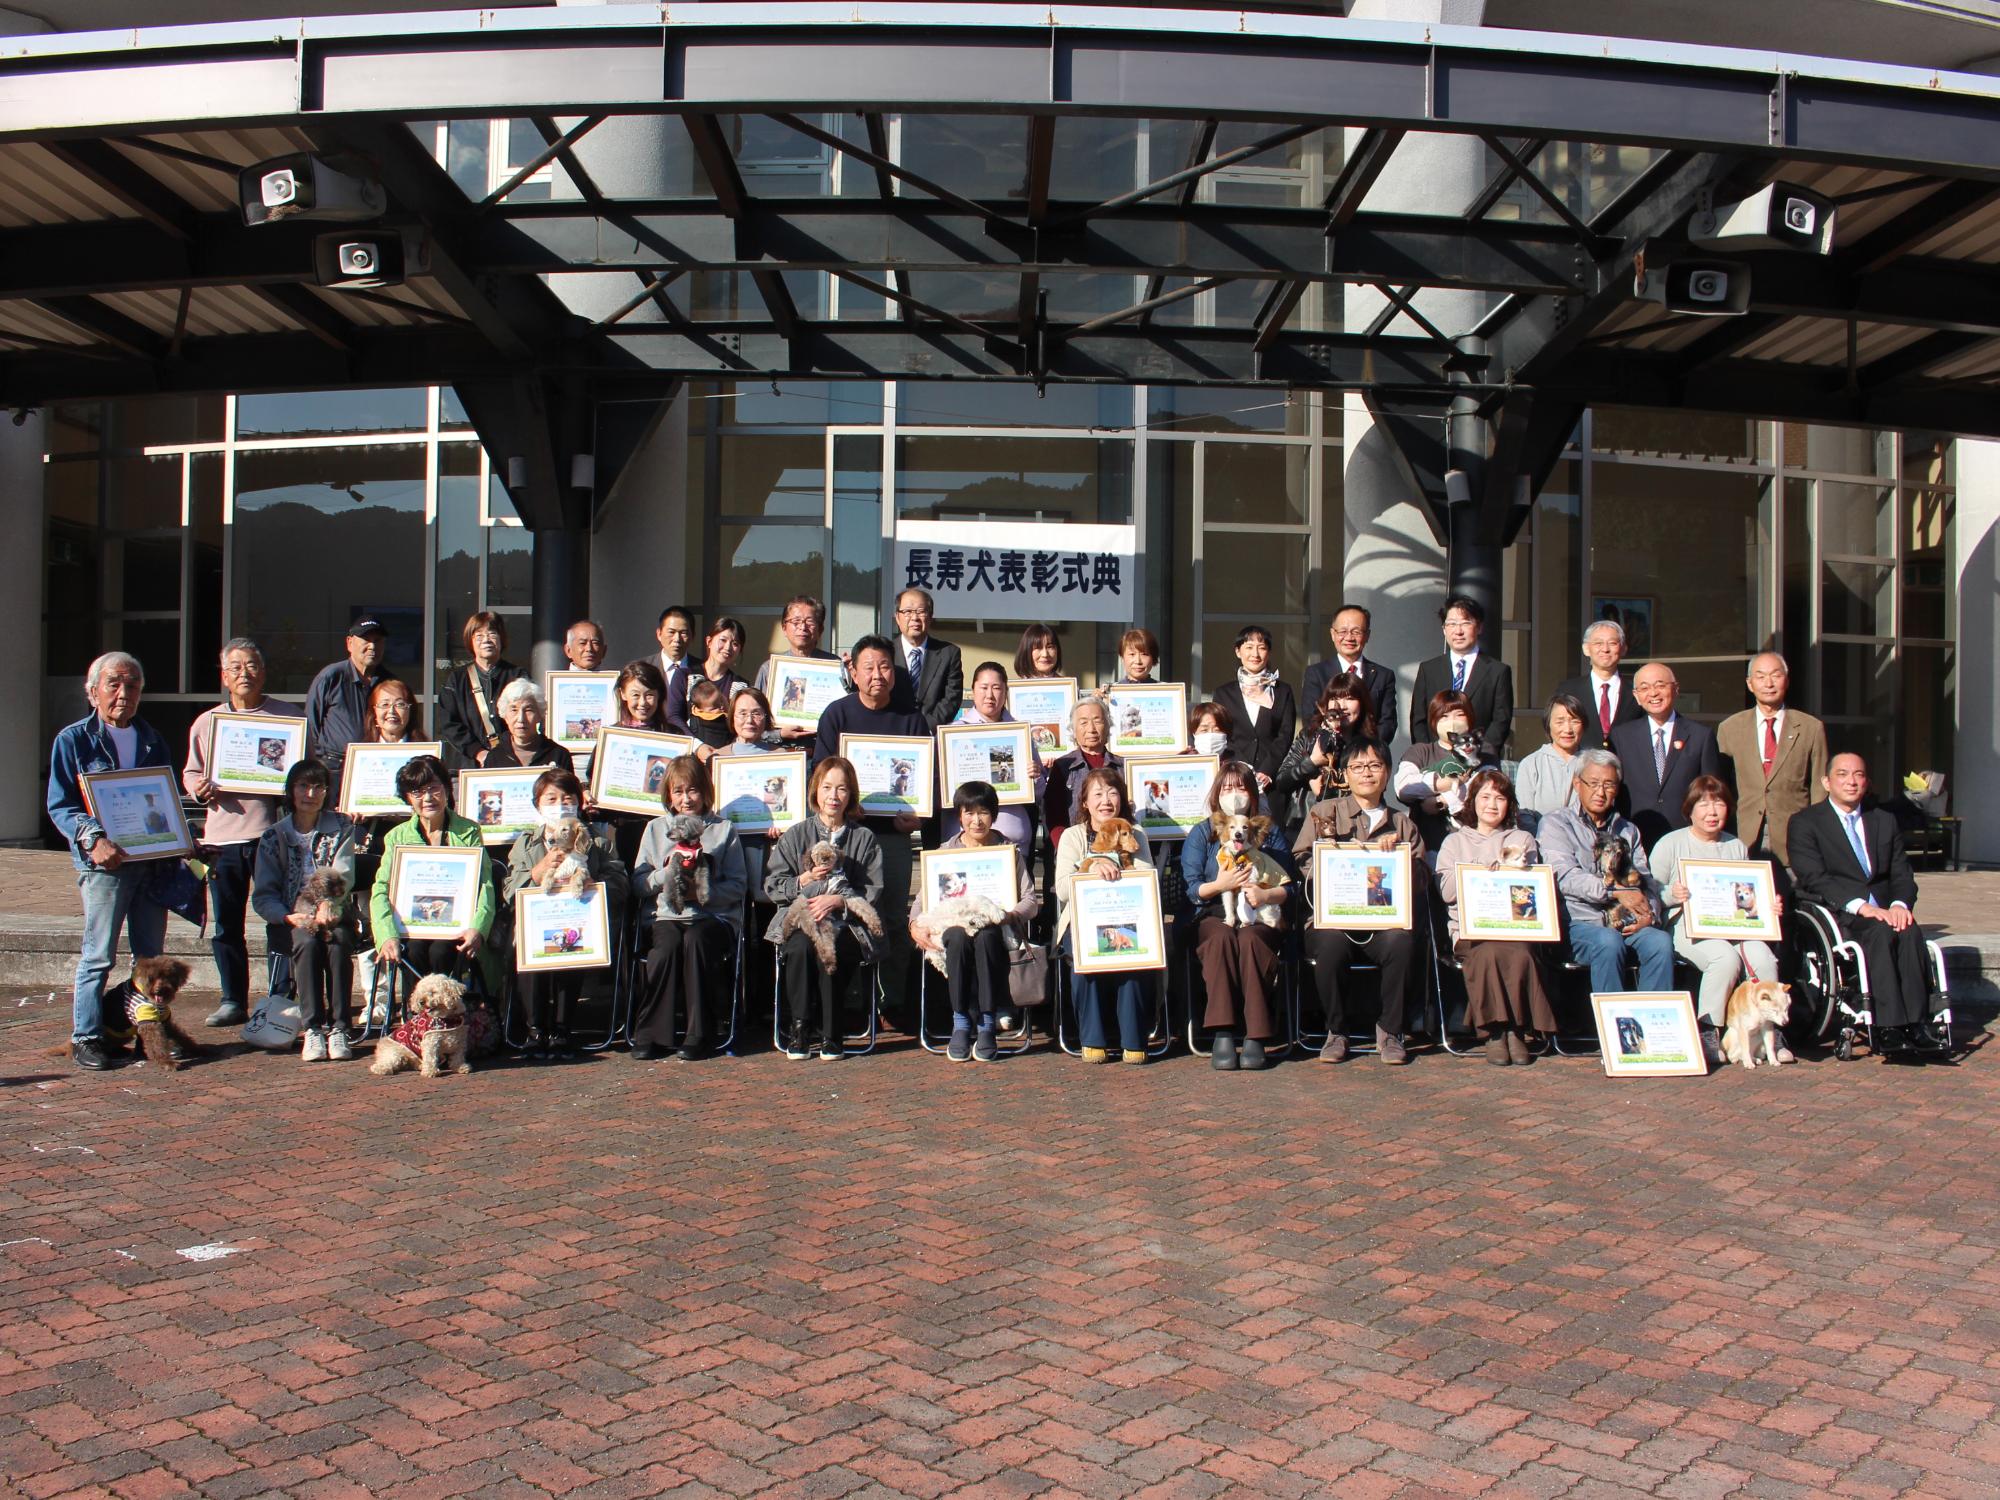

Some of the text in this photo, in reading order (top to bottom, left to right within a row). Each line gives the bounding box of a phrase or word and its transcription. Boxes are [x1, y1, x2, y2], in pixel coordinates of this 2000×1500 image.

[905, 549, 1121, 595] 長寿犬表彰式典
